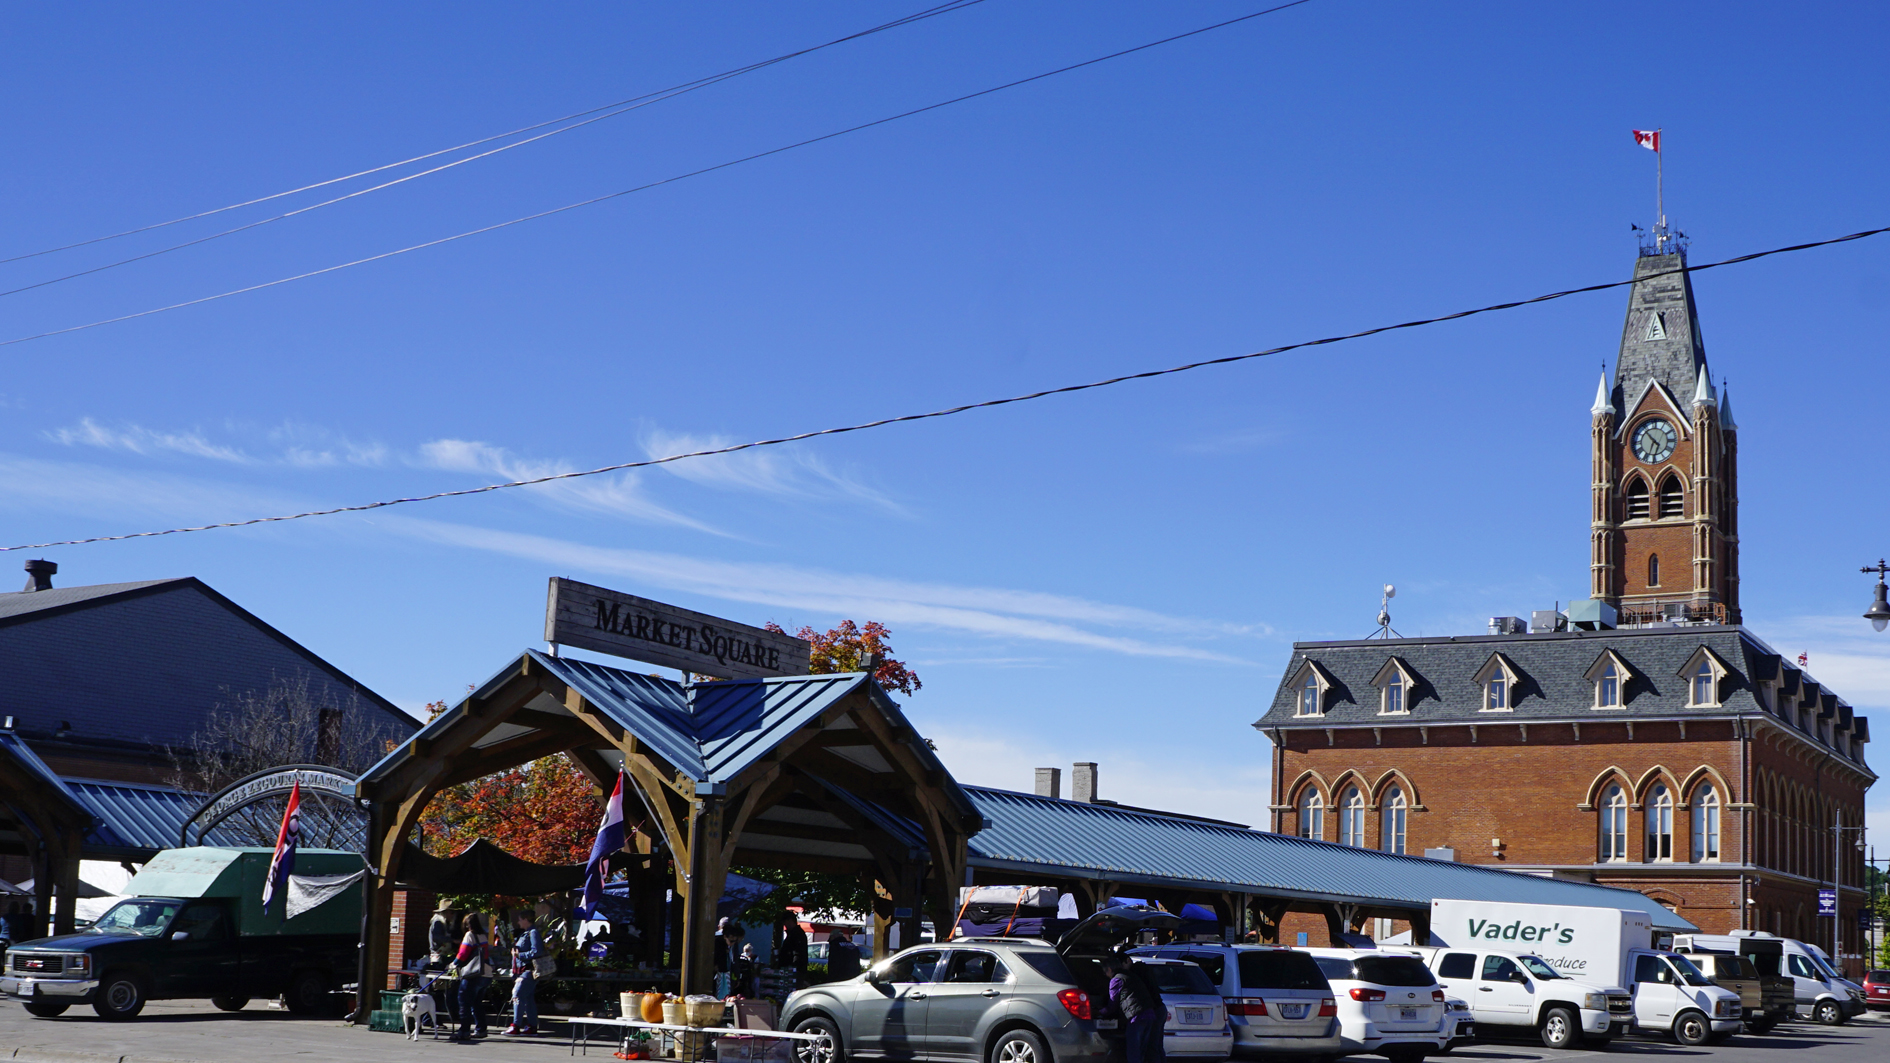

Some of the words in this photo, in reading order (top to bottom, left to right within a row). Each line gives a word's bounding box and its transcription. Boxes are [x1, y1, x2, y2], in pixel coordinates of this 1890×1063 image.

[594, 600, 697, 650] MARKET
[699, 625, 781, 671] SQUARE
[1468, 918, 1575, 944] Vader's
